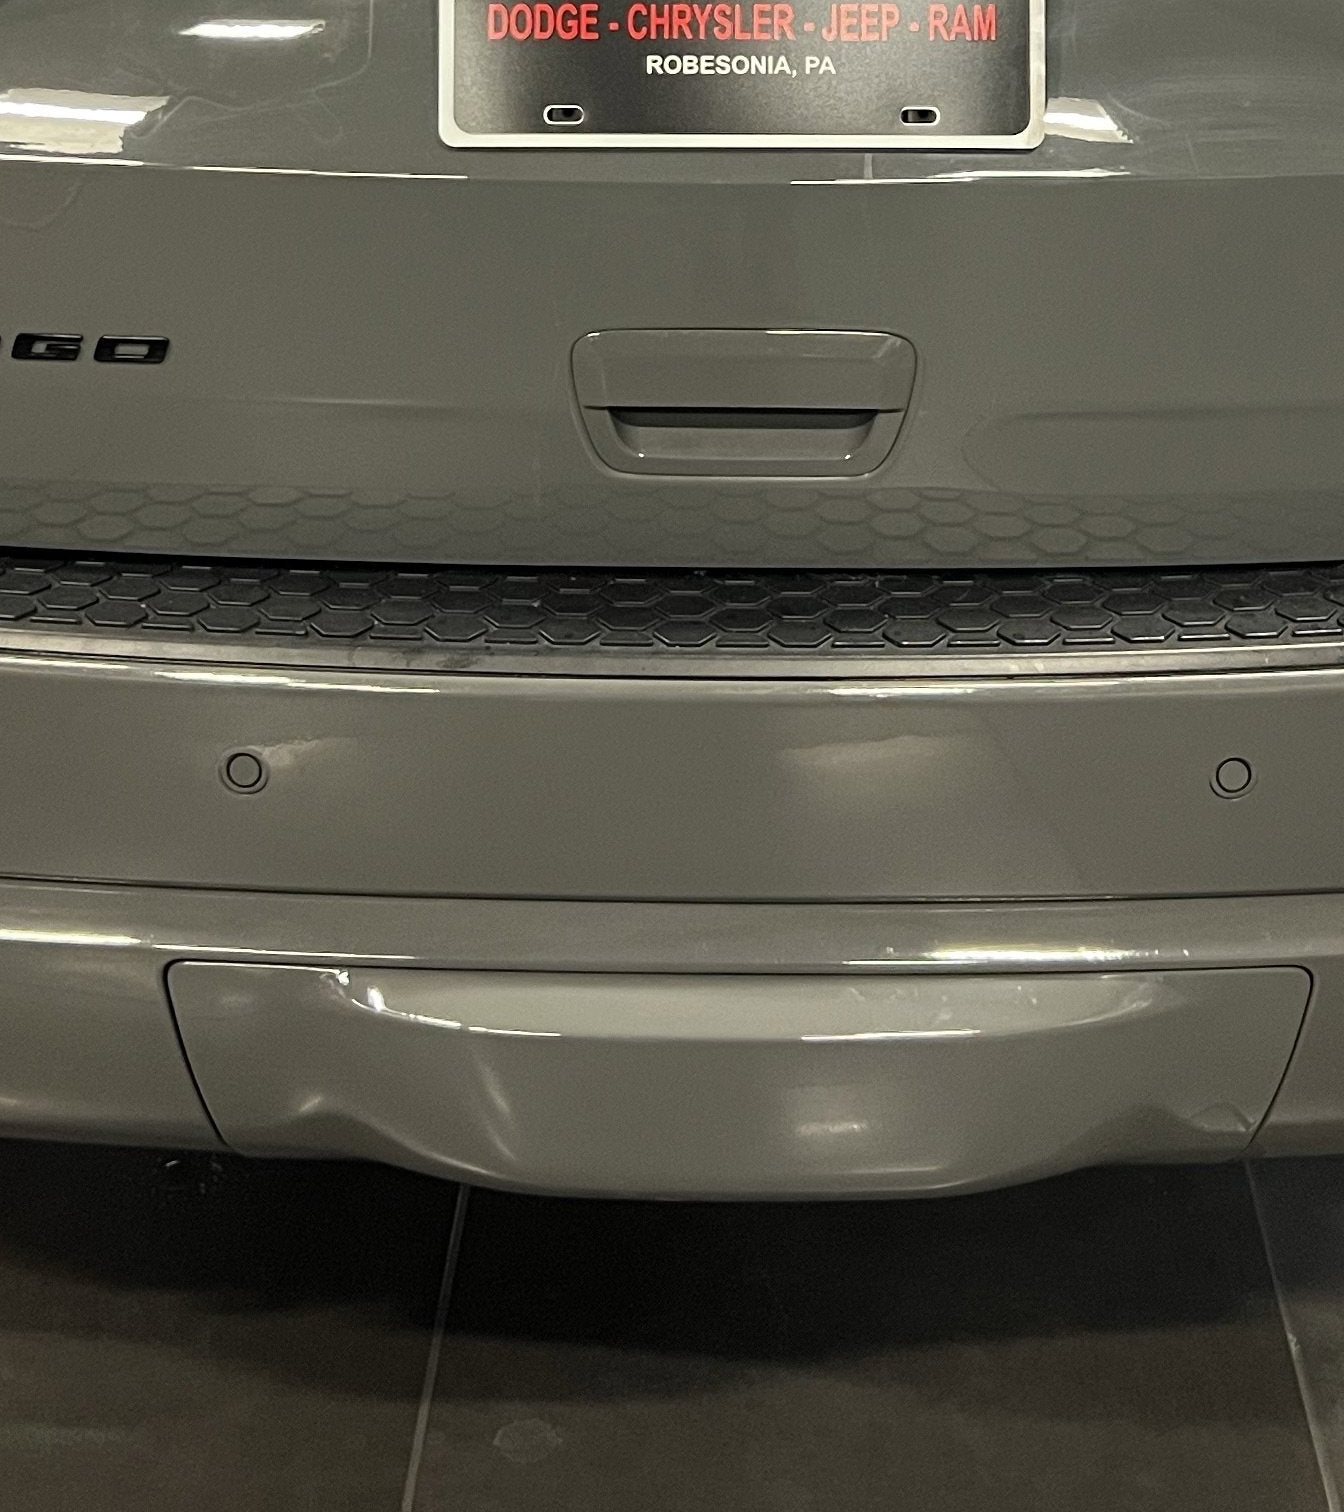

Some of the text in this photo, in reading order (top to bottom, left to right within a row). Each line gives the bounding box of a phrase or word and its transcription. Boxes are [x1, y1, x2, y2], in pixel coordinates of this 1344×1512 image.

[487, 2, 600, 42] DODGE
[627, 2, 796, 42] CHRYSLER
[821, 2, 902, 42] JEEP
[927, 2, 998, 42] RAM
[646, 55, 837, 78] ROBESONIA, PA
